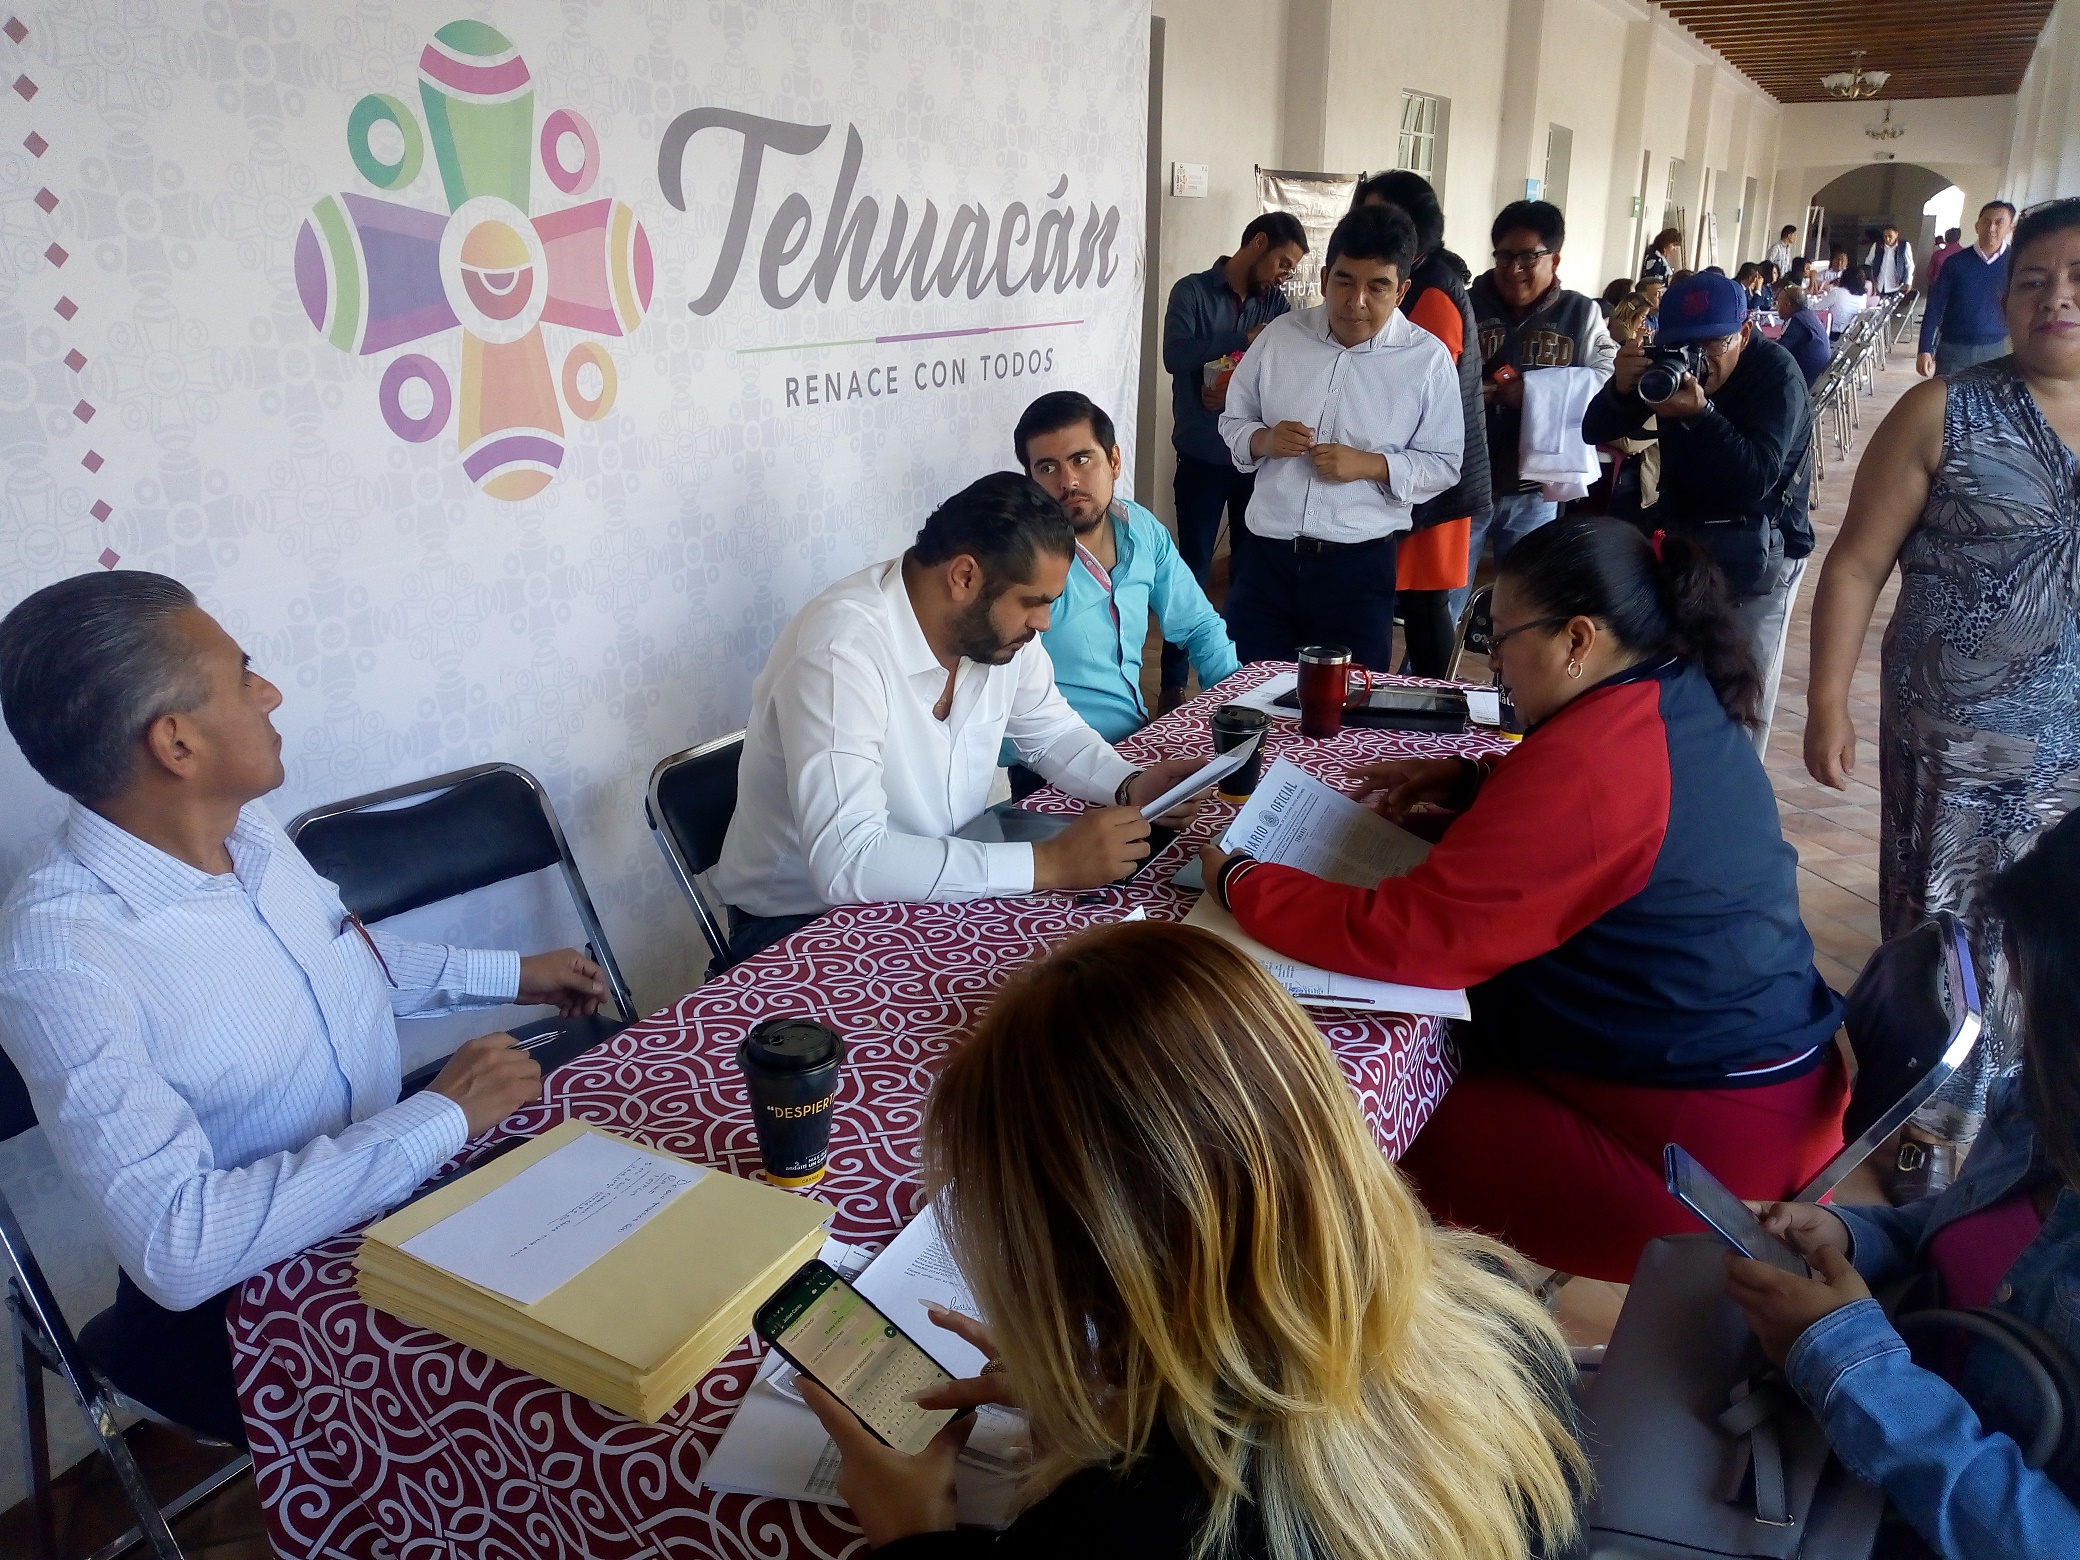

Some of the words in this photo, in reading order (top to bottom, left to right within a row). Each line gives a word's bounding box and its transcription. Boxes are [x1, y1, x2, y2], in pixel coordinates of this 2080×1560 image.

[658, 107, 1120, 316] Tehuacán
[785, 366, 899, 408] RENACE
[914, 358, 966, 390] CON
[980, 347, 1054, 381] TODOS
[1270, 781, 1298, 813] OFICIAL
[766, 1091, 835, 1118] “DESPIERT
